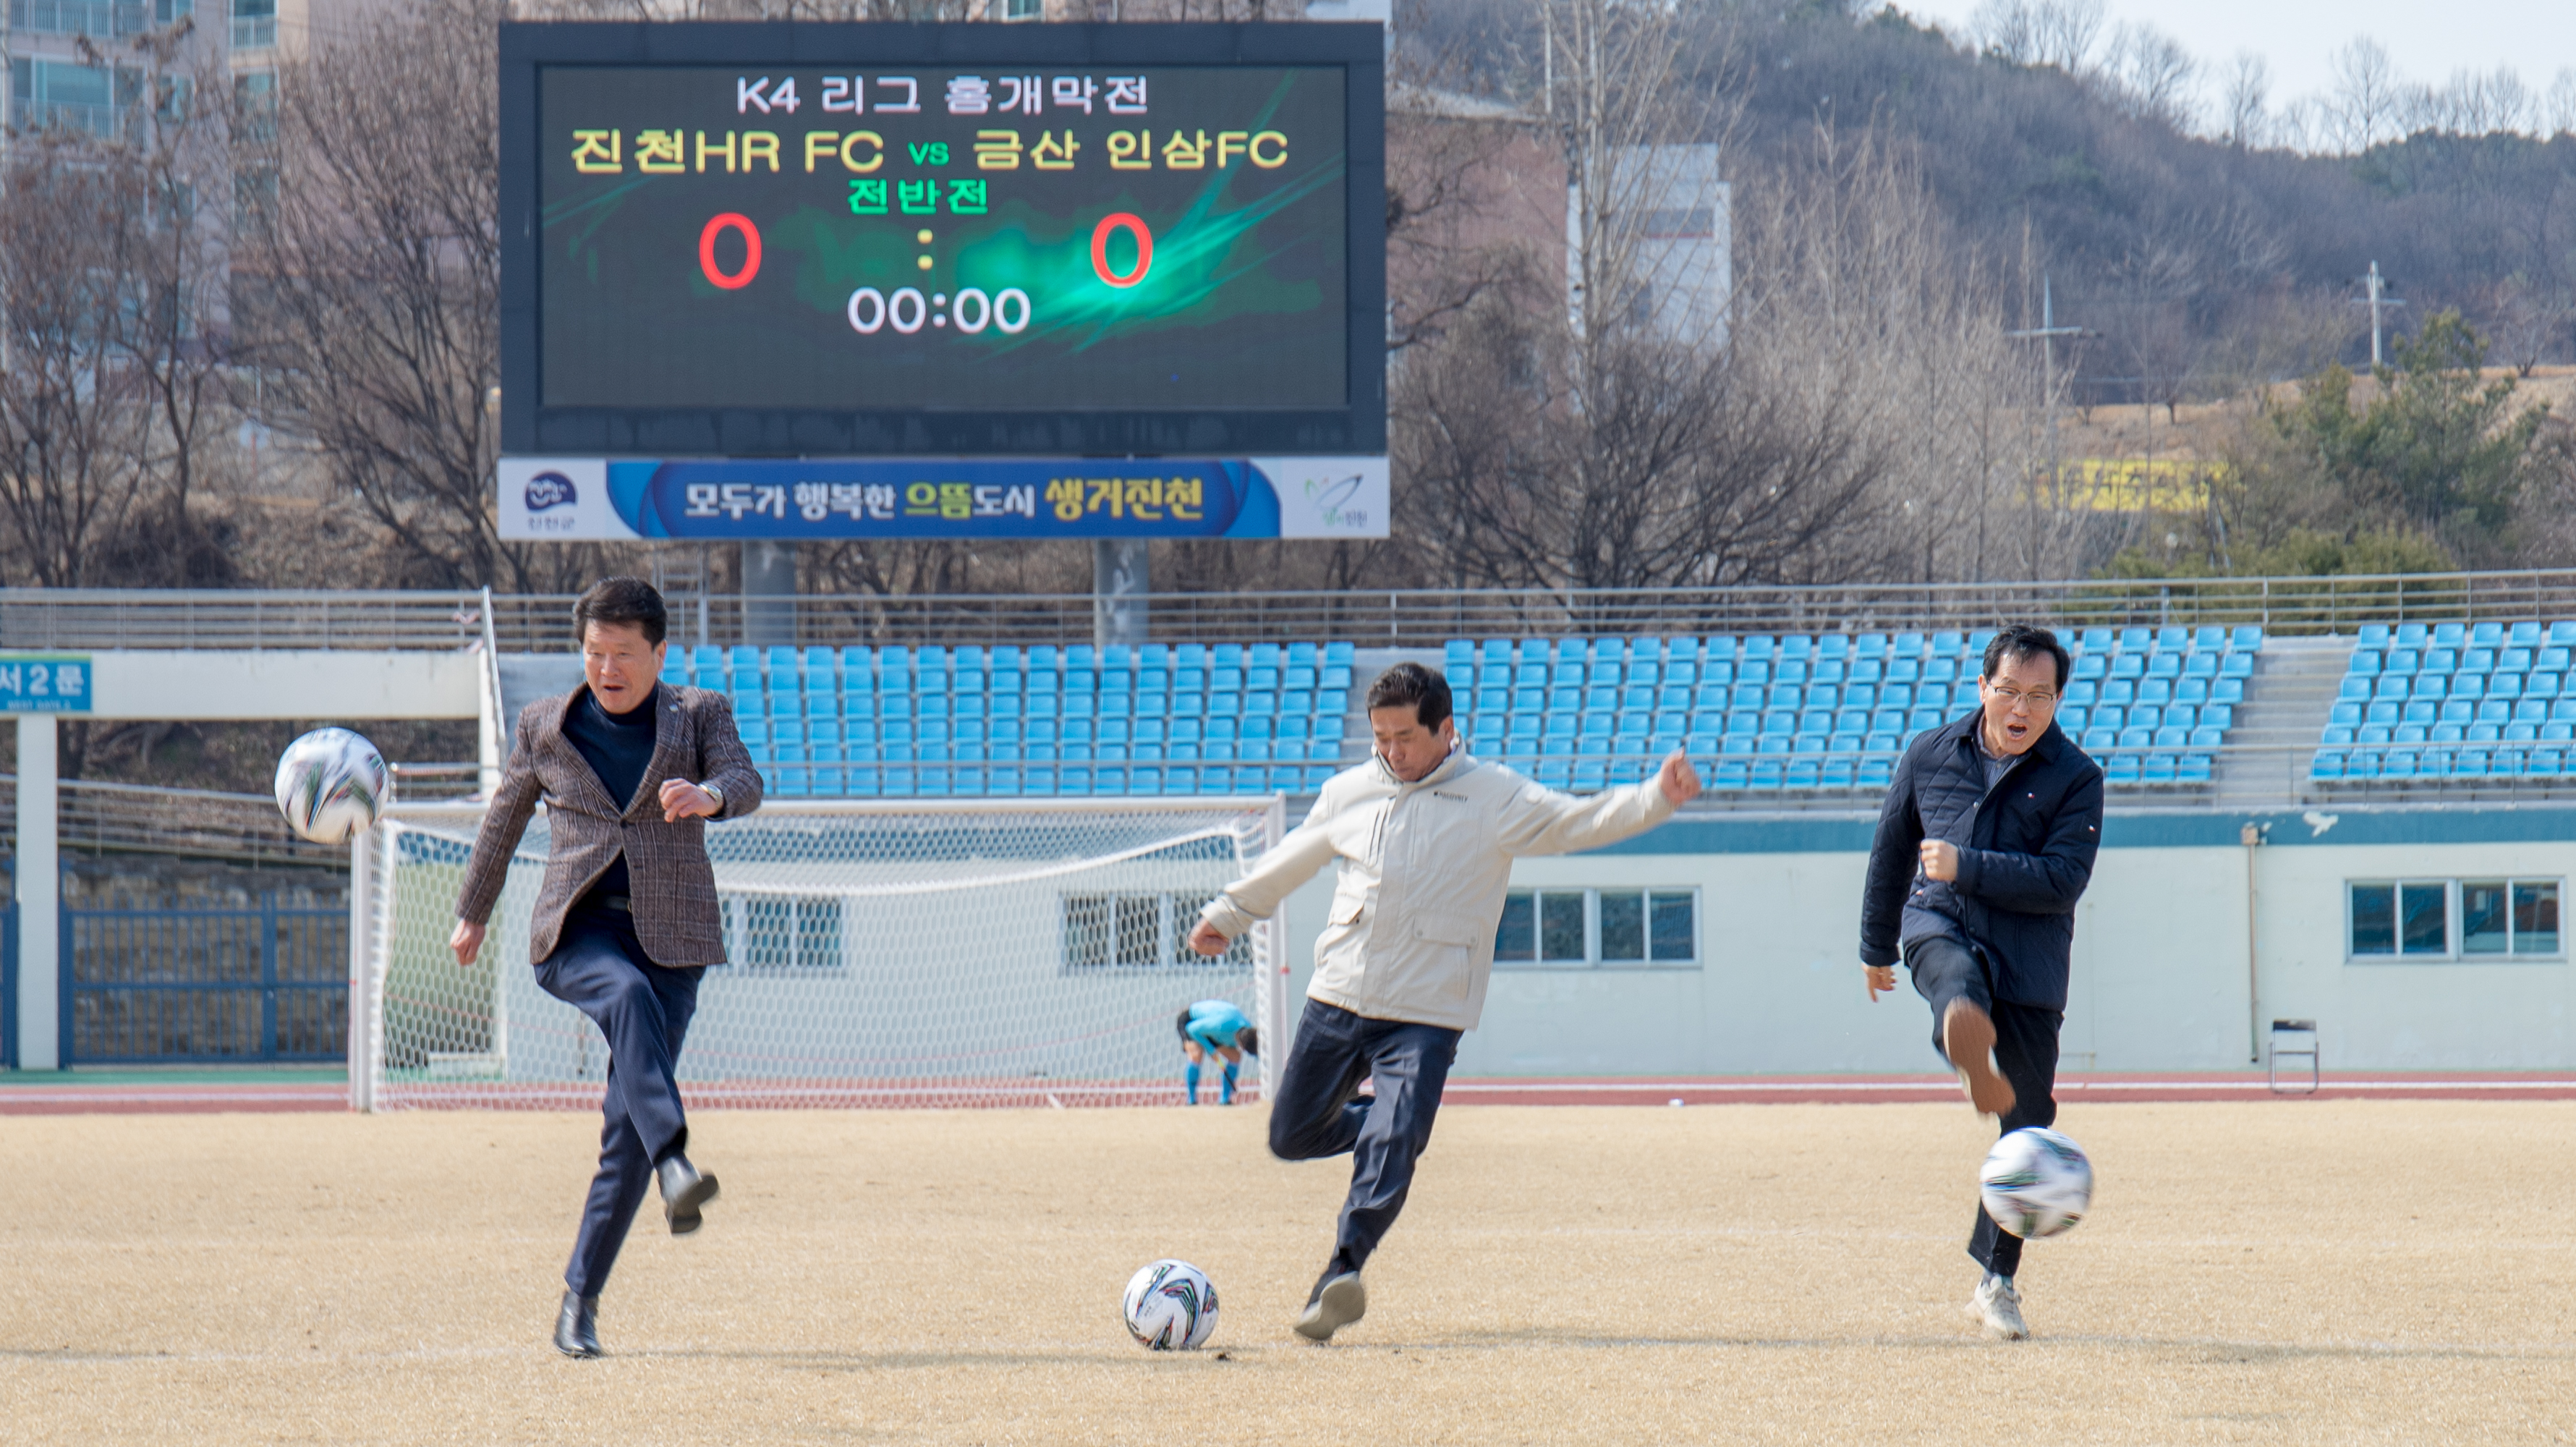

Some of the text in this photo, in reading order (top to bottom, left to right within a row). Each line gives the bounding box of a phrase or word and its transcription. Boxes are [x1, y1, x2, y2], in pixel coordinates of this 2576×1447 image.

[737, 76, 800, 114] K4
[822, 75, 922, 114] 리그
[571, 128, 781, 174] 진천HR
[804, 130, 884, 172] FC
[973, 129, 1081, 170] 금산
[1107, 128, 1288, 170] 인삼FC
[849, 179, 988, 215] 전반전
[699, 213, 762, 289] 0
[1091, 212, 1153, 289] 0
[848, 287, 1032, 334] 00:00
[684, 482, 786, 521] 모두가
[794, 480, 897, 522] 행복한
[1045, 478, 1203, 521] 생거진천
